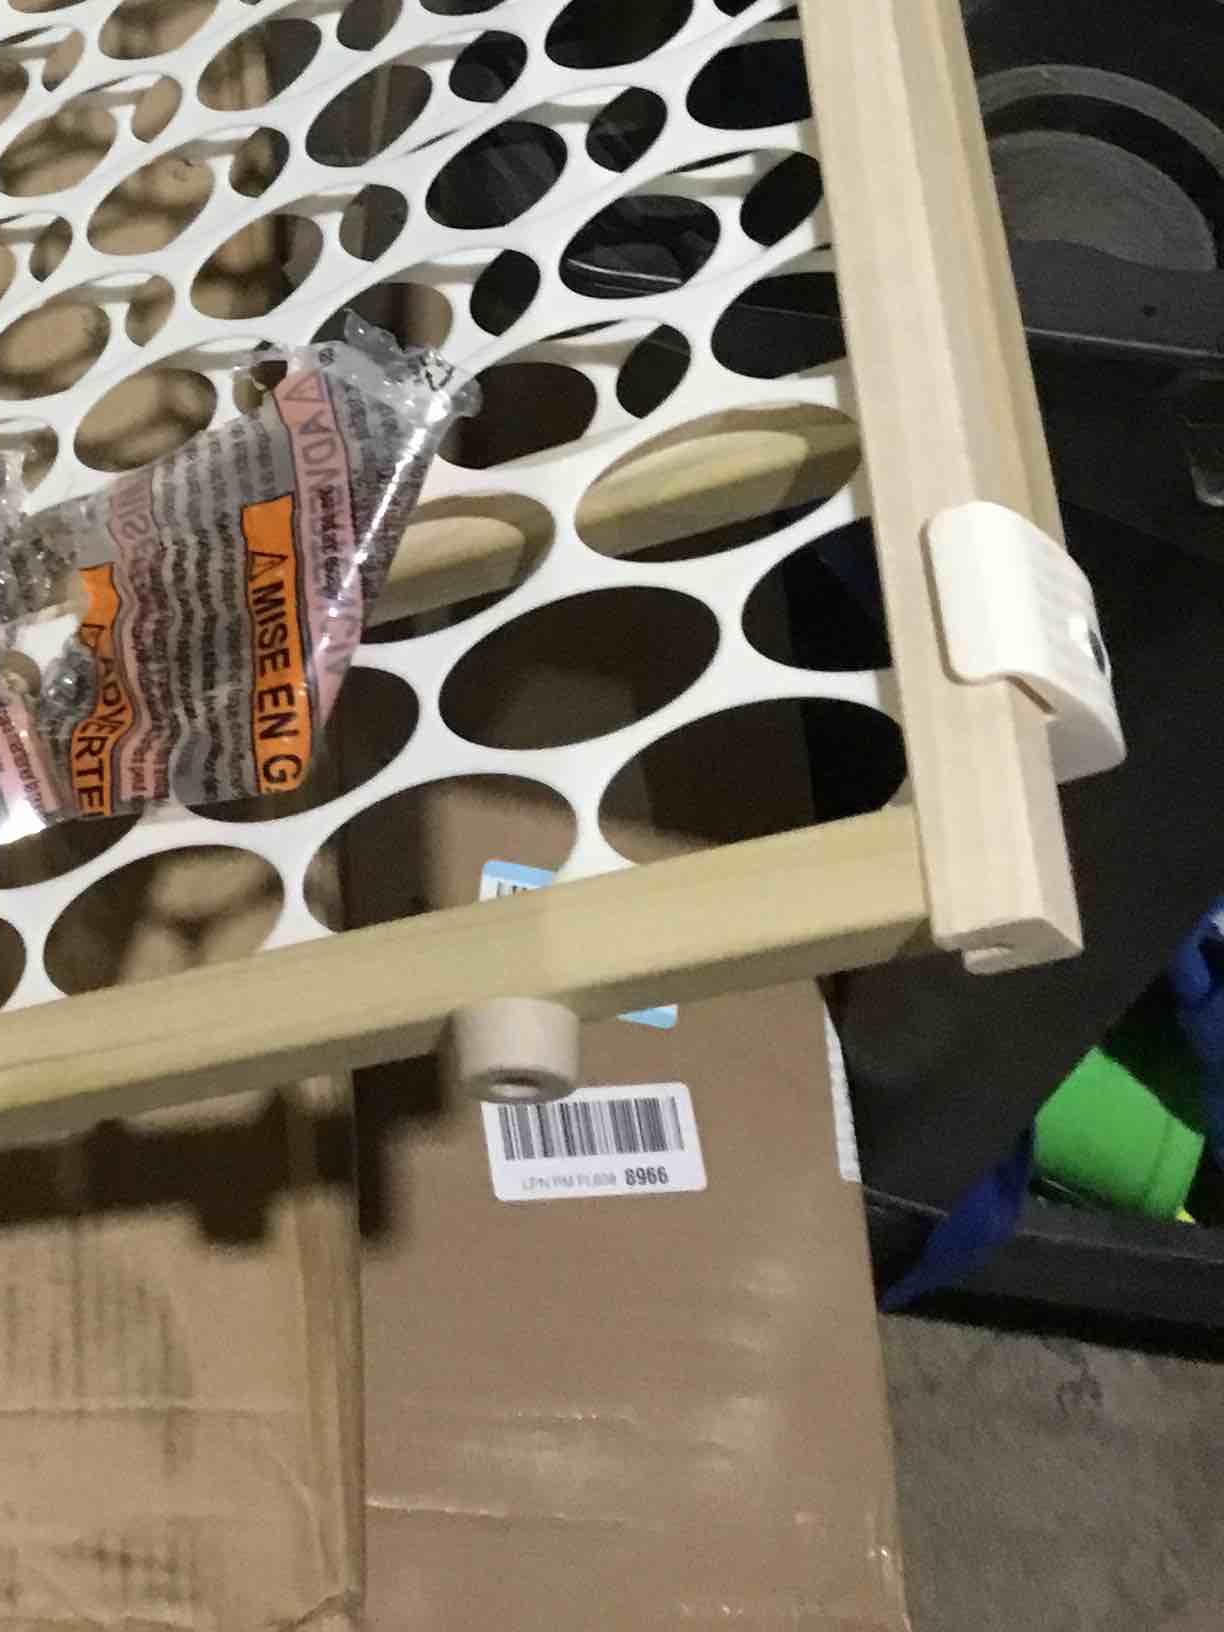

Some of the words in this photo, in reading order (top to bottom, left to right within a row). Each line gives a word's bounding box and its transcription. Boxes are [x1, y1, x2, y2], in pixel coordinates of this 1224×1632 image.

[252, 581, 291, 677] MISE
[256, 684, 297, 741] EN
[624, 1165, 670, 1186] 8966
